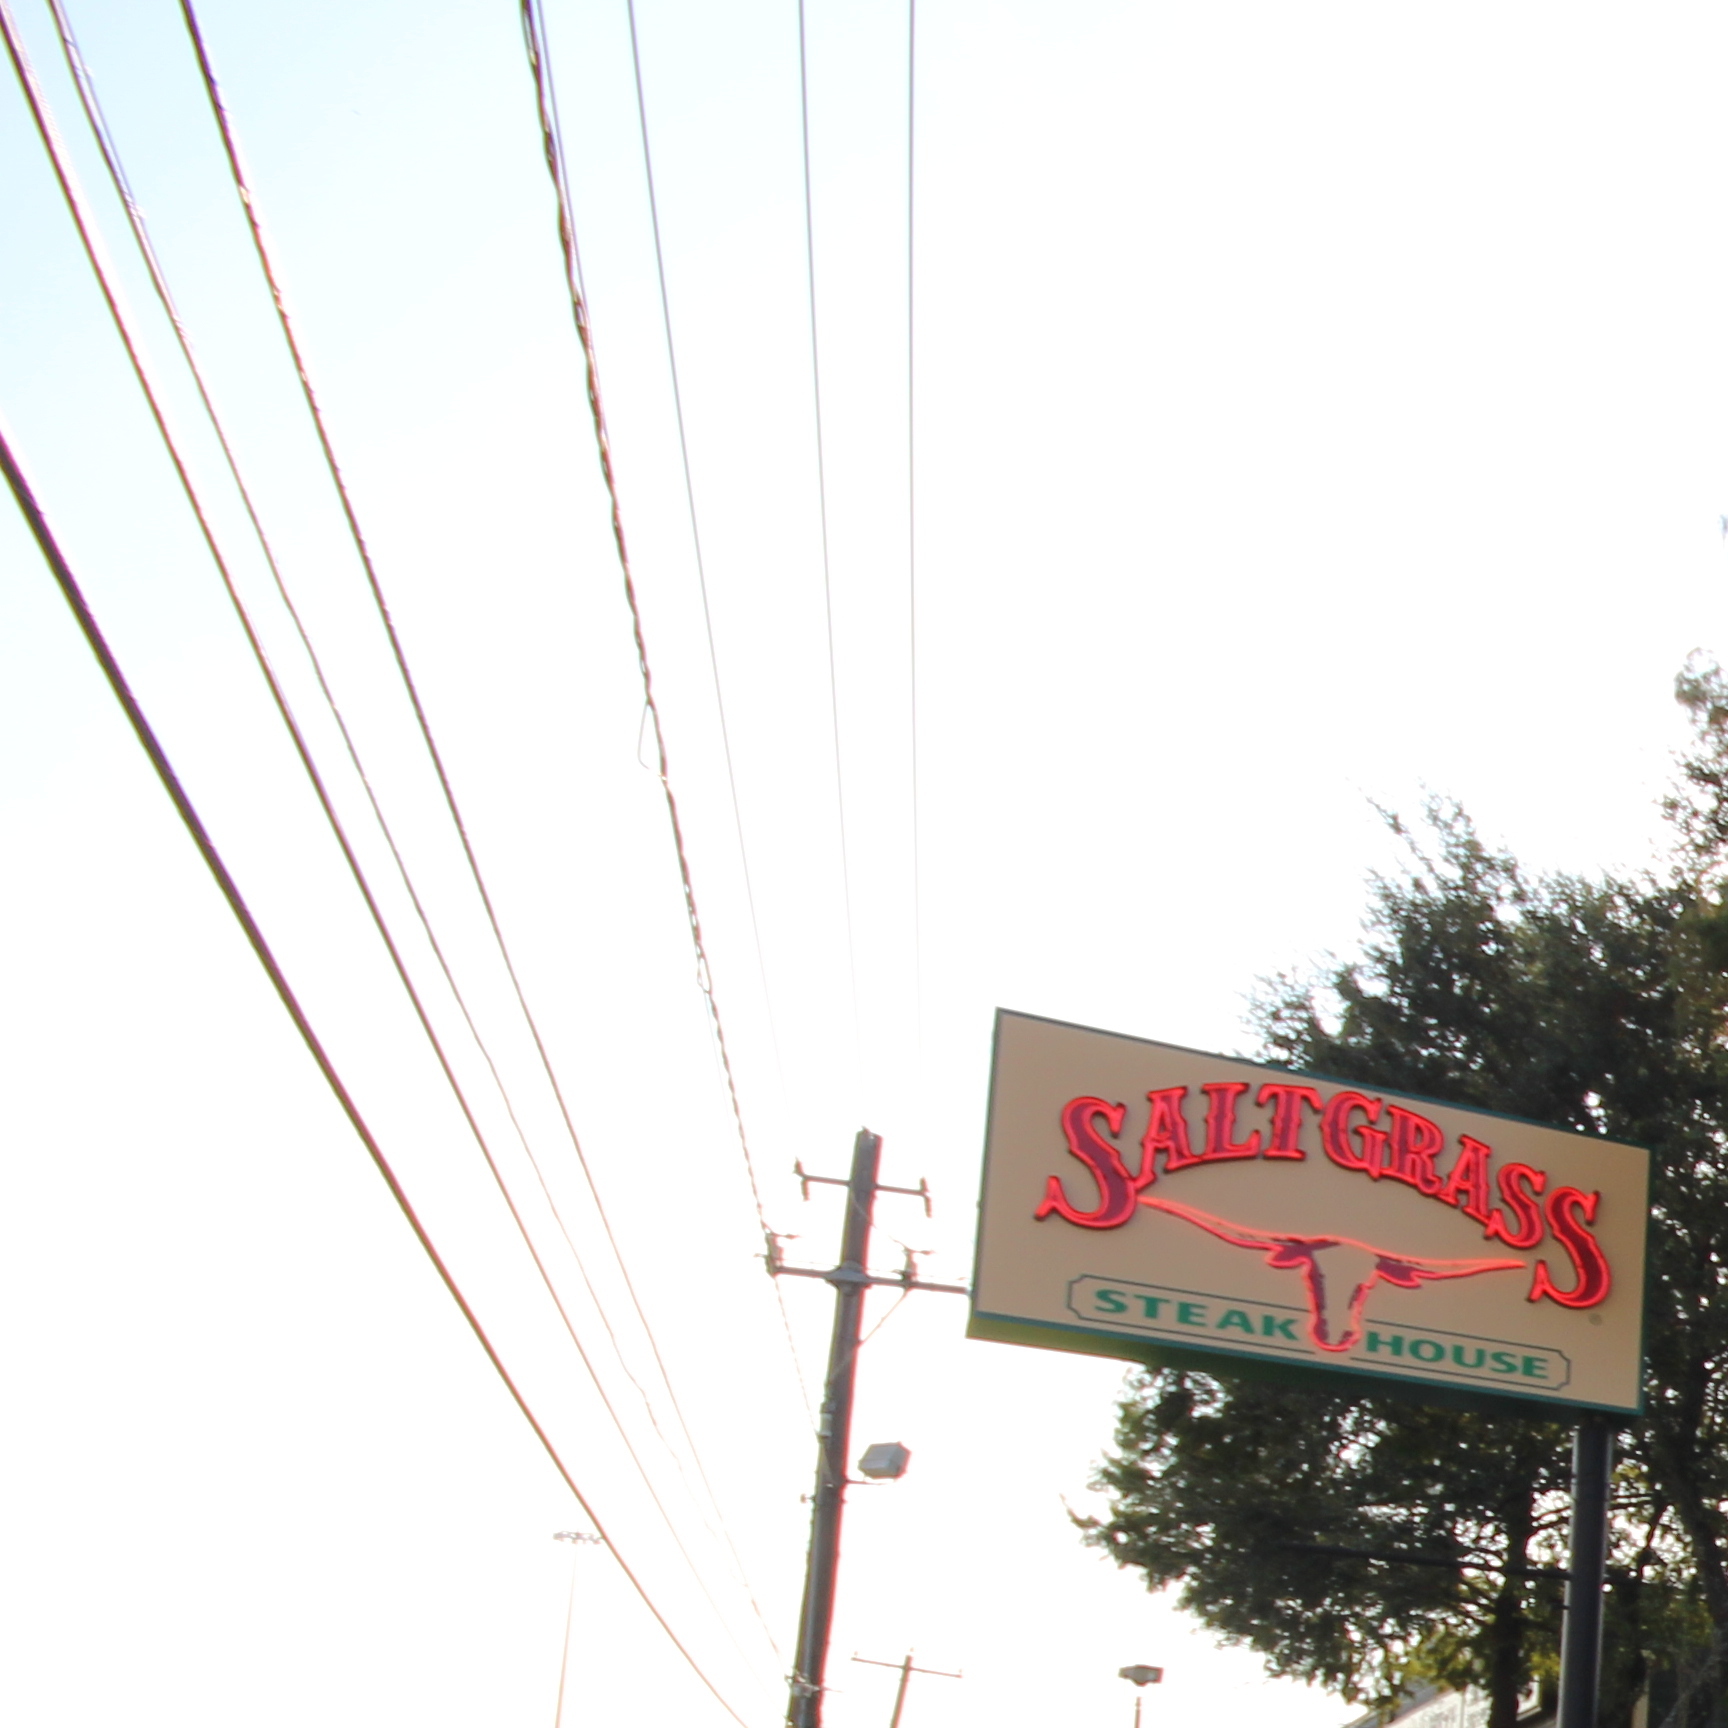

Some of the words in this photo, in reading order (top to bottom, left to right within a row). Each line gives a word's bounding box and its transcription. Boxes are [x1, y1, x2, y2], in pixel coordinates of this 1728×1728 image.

[1035, 1081, 1611, 1308] SALTGRASS
[1094, 1288, 1300, 1341] STEAK
[1366, 1333, 1549, 1380] HOUSE
